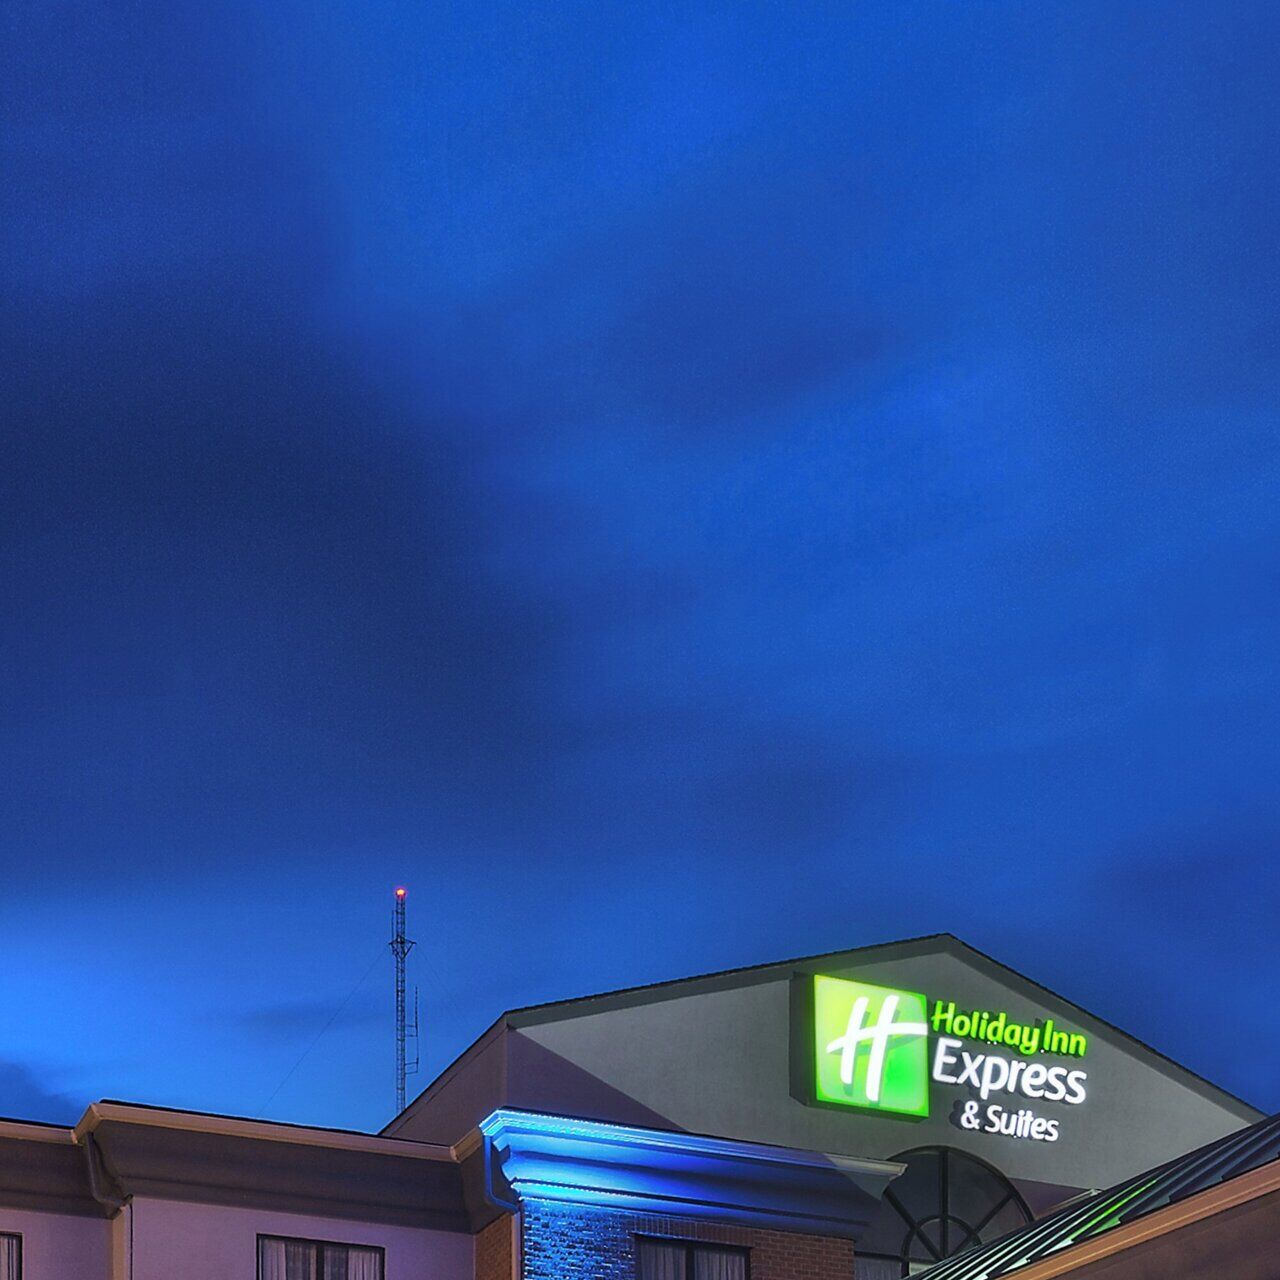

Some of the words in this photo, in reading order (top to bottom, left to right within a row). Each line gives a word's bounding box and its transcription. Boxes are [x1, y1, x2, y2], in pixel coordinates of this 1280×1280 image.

[930, 1000, 1041, 1056] Holiday
[1042, 1019, 1087, 1057] Inn
[932, 1036, 1087, 1105] Express
[960, 1100, 981, 1130] &
[984, 1104, 1060, 1142] Suites
